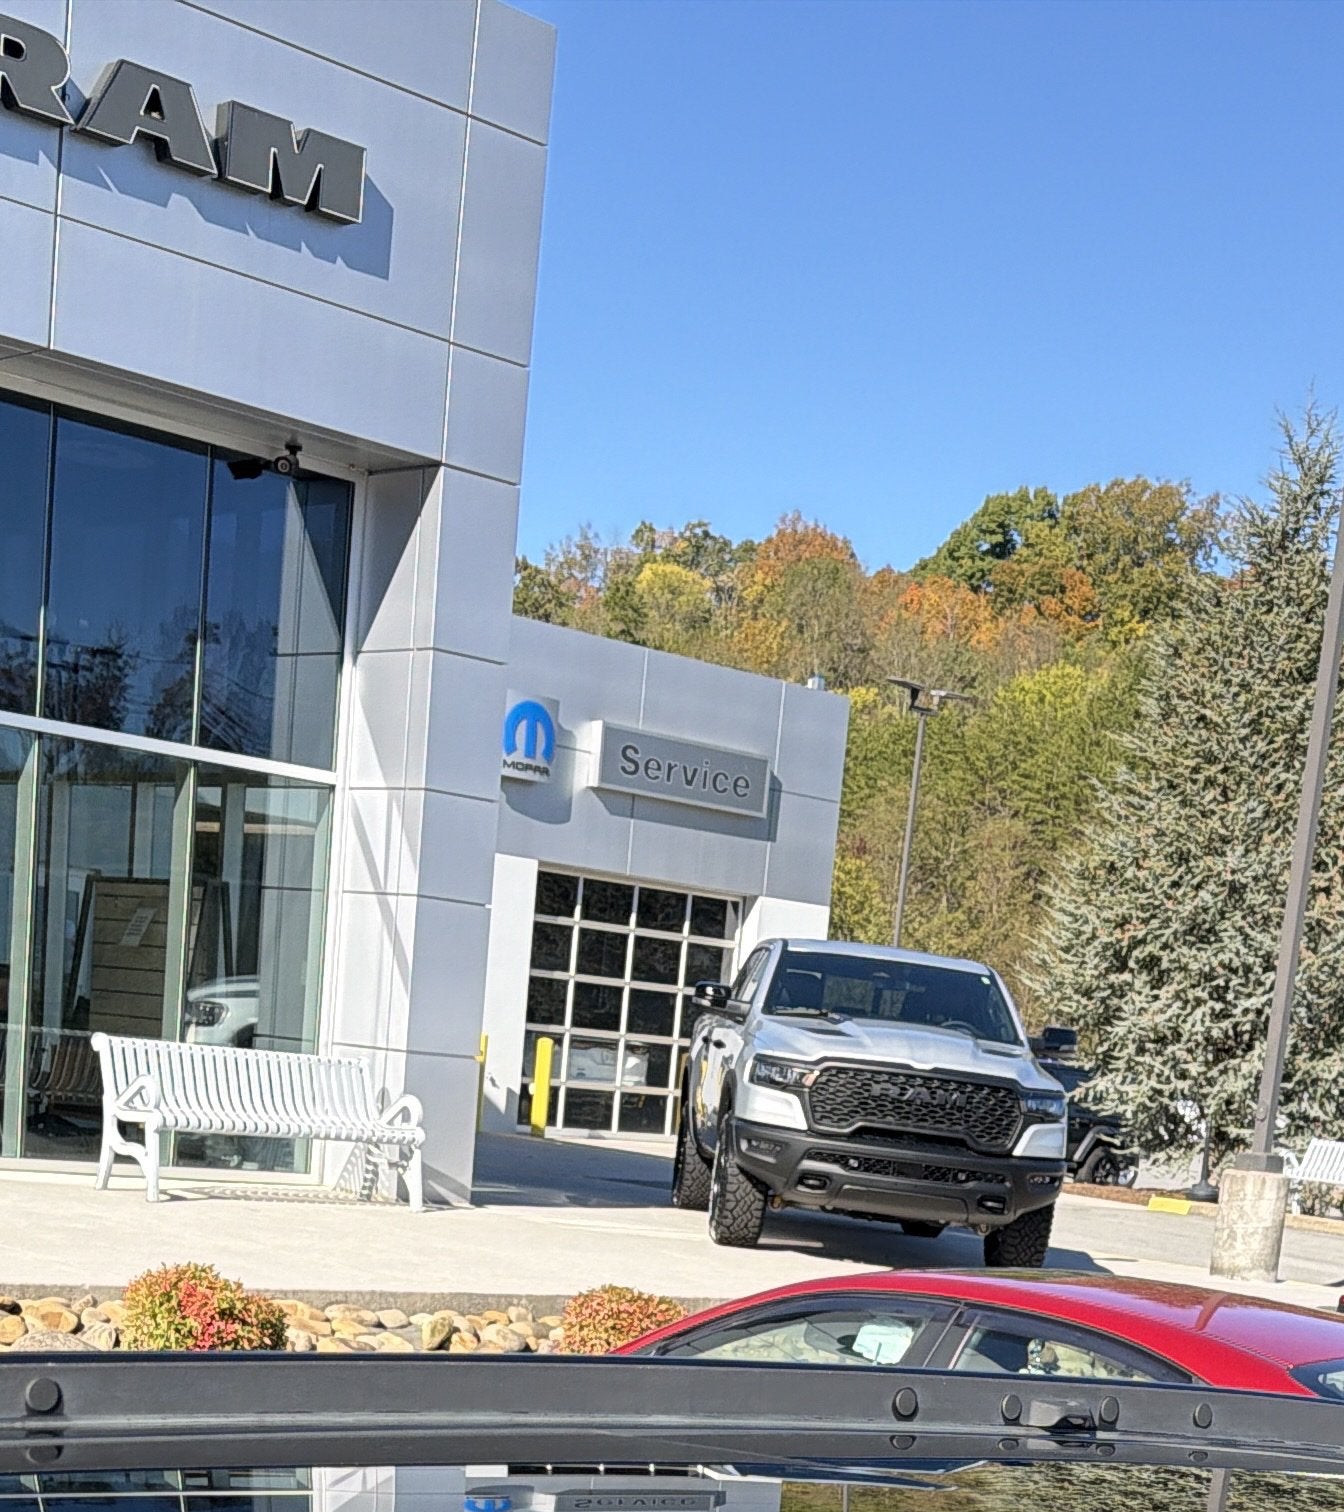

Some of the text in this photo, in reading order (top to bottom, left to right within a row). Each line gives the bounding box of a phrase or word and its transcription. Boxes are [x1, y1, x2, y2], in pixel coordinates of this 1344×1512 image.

[502, 758, 551, 778] MOPAR
[619, 744, 751, 798] Service
[869, 1079, 969, 1108] RAM
